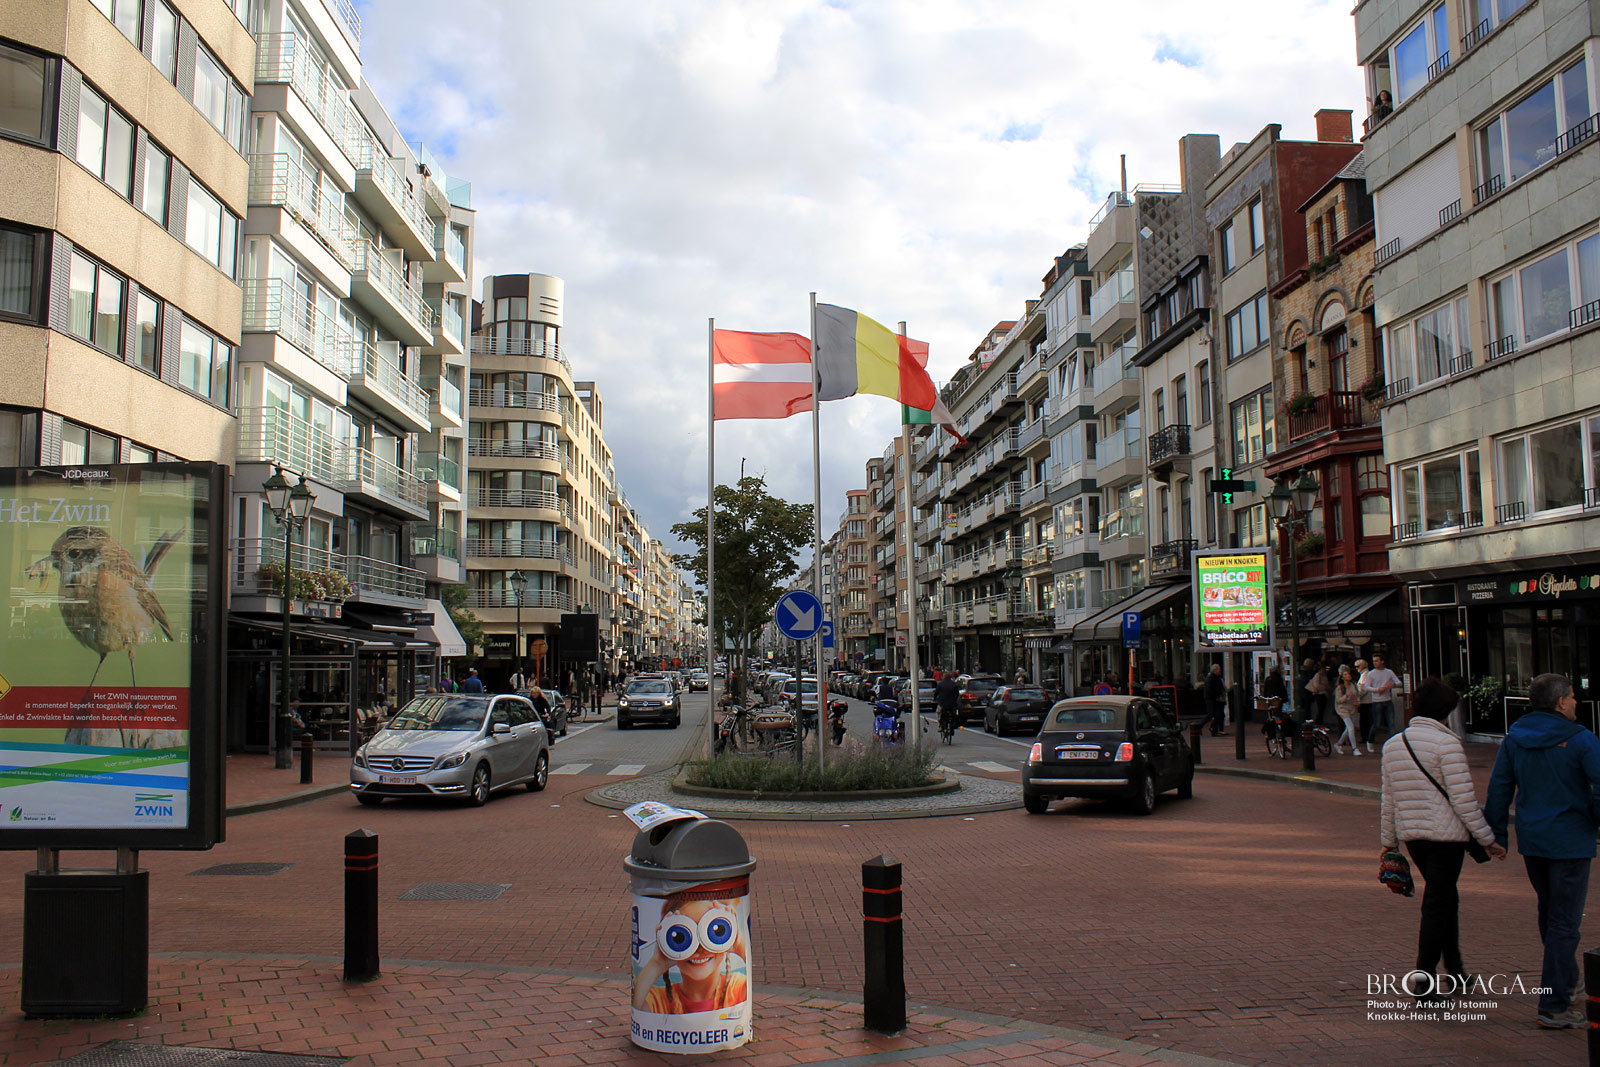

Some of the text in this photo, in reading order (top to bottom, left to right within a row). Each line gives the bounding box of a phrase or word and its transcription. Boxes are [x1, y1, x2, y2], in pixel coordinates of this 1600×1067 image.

[62, 470, 109, 479] JCDecaux
[0, 497, 111, 523] Het Zwin
[1234, 557, 1258, 565] KNOKKE
[1467, 582, 1498, 591] RISTORANTE
[1539, 572, 1578, 599] Rigoletto
[1472, 592, 1494, 600] PIZZERIA
[1127, 614, 1137, 628] P
[822, 625, 831, 636] P
[94, 692, 177, 701] Het ZWIN natuurcentrum
[69, 702, 95, 710] beperkt
[96, 702, 134, 711] toegankelijk
[26, 713, 62, 721] Zwinvlakte
[63, 713, 75, 721] kan
[134, 805, 173, 817] ZWIN
[642, 1028, 654, 1041] en
[656, 1028, 729, 1046] RECYCLEER
